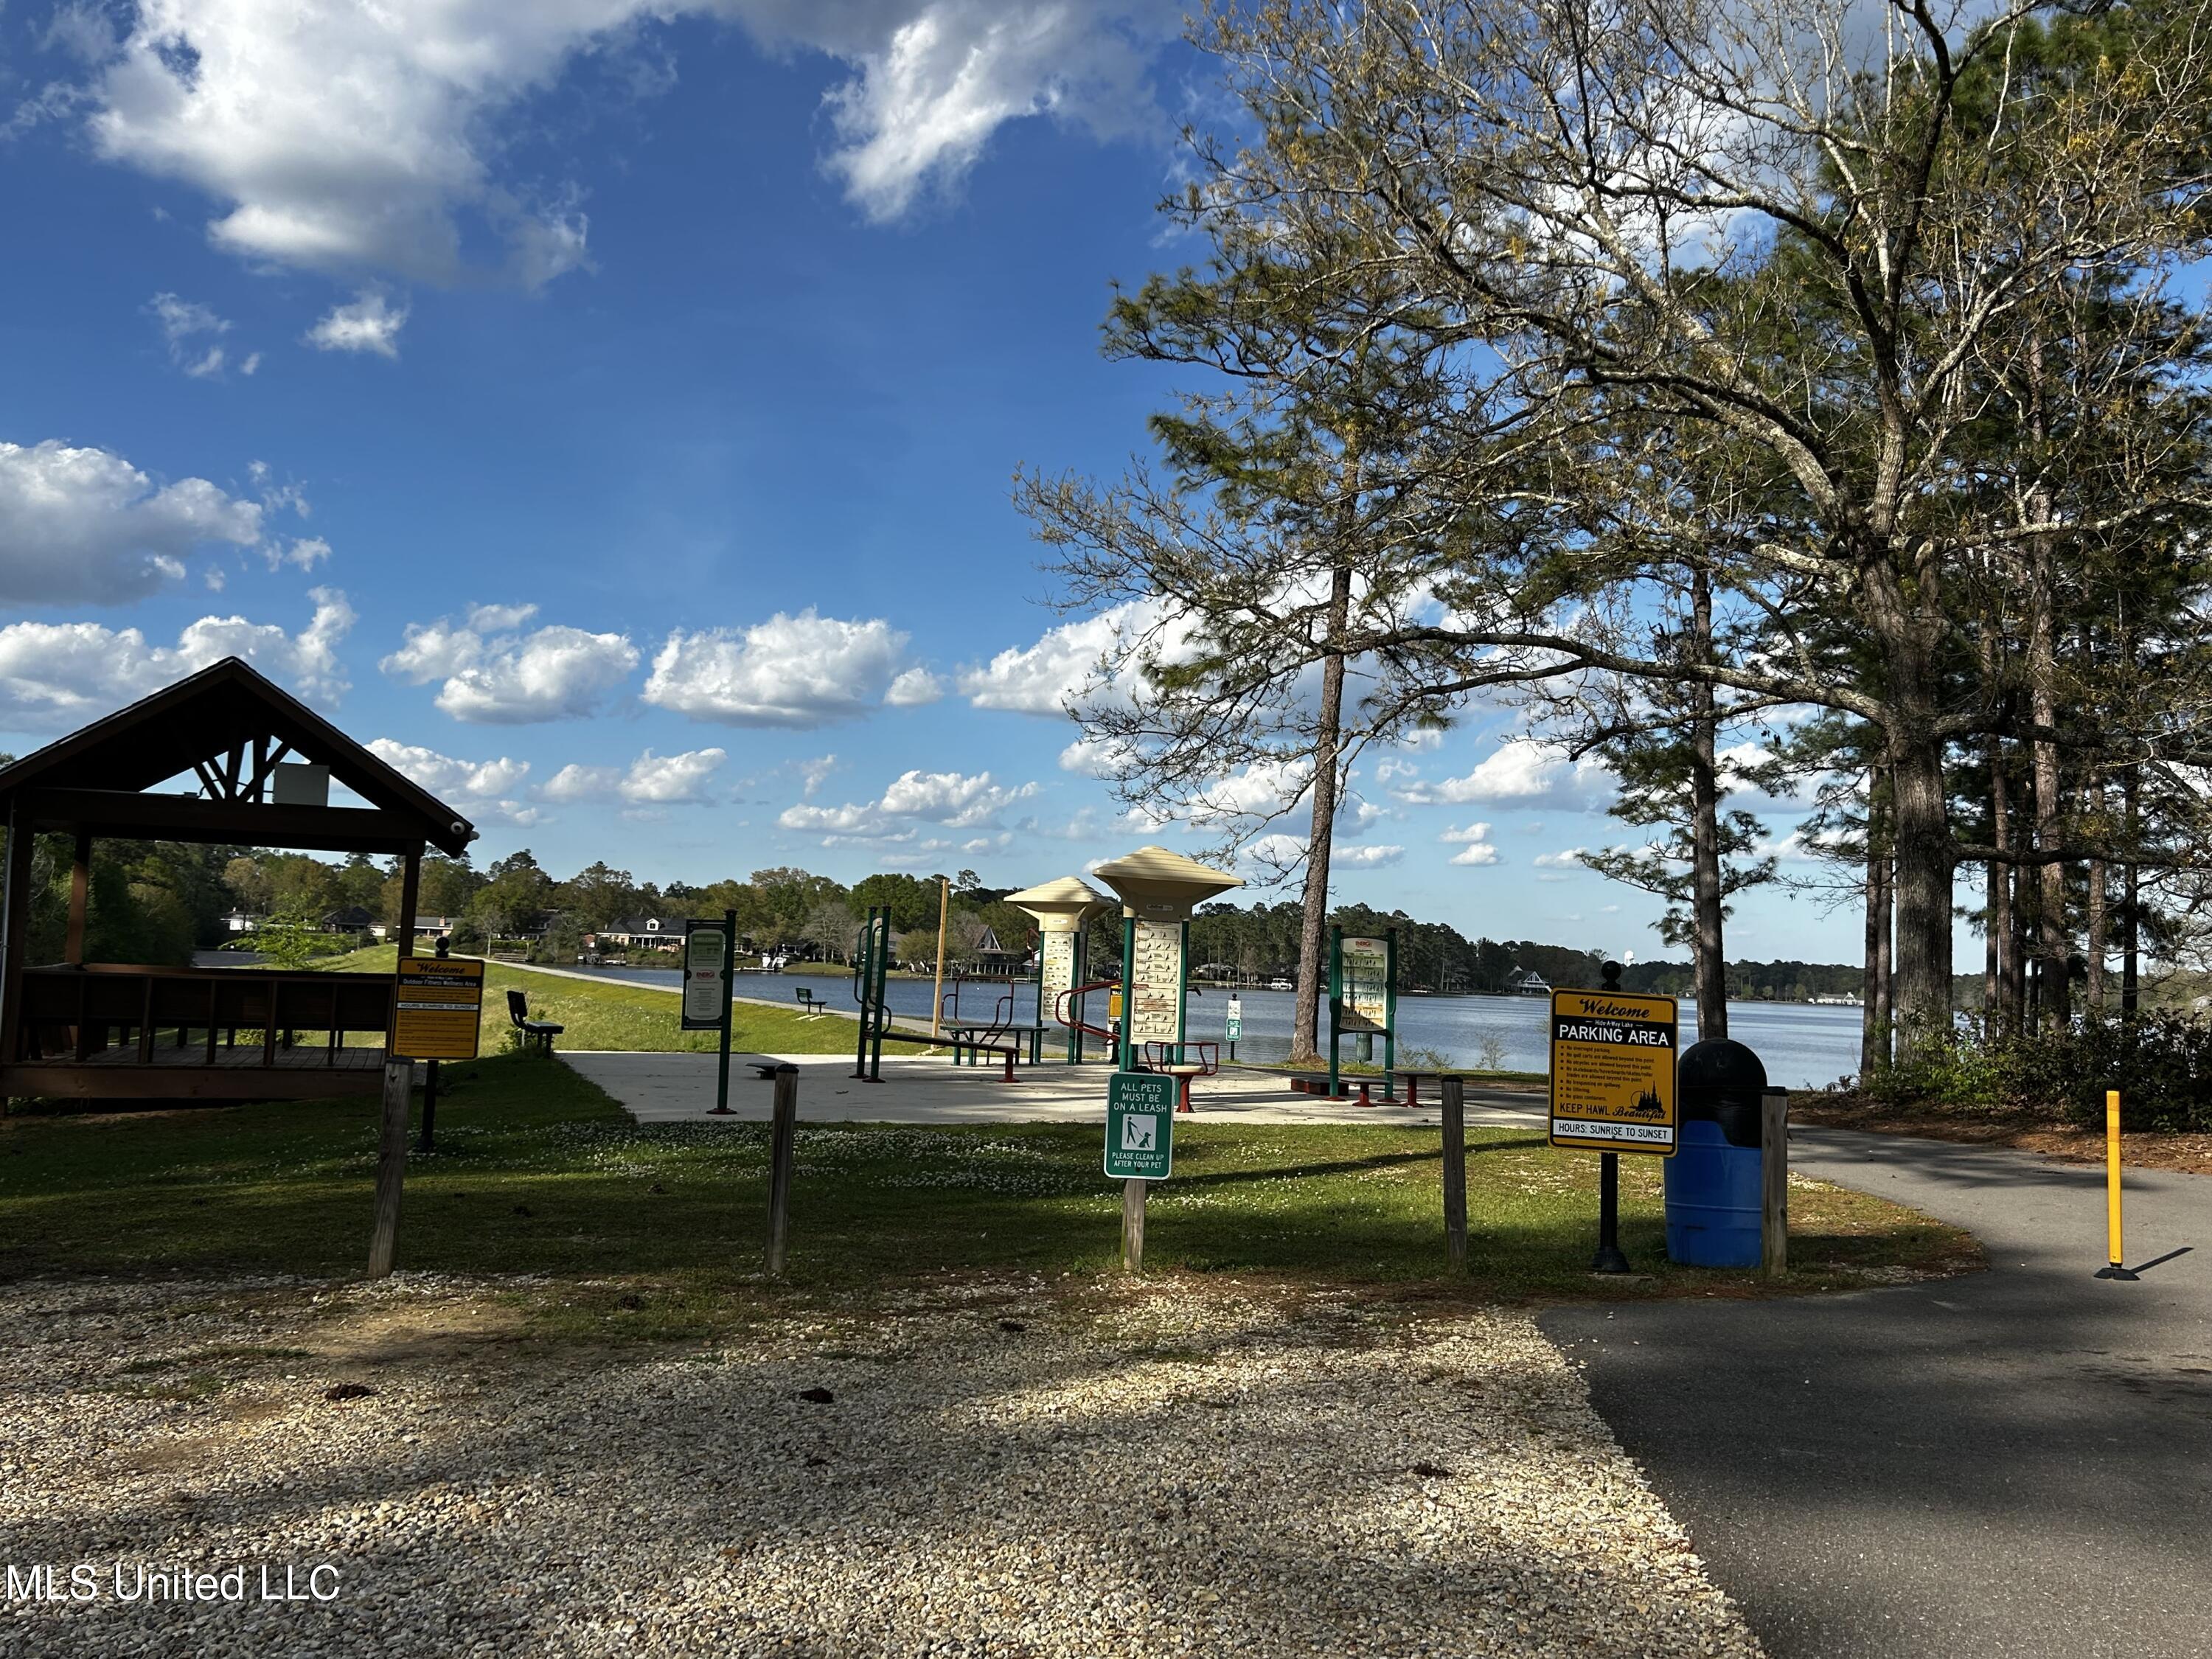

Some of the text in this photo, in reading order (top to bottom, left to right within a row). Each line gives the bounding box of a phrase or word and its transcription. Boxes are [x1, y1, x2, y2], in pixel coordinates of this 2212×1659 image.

[417, 962, 465, 974] Welcome
[1579, 998, 1650, 1018] Welcome
[1559, 1025, 1669, 1045] PARKING AREA
[1120, 1083, 1162, 1092] ALL PETS
[1122, 1093, 1160, 1103] MUST BE
[1114, 1102, 1167, 1112] ON A LEASH
[1560, 1103, 1666, 1122] KEEP HAWL Beautiful
[1559, 1123, 1667, 1139] HOURS: SUNRISE TO SUNSET
